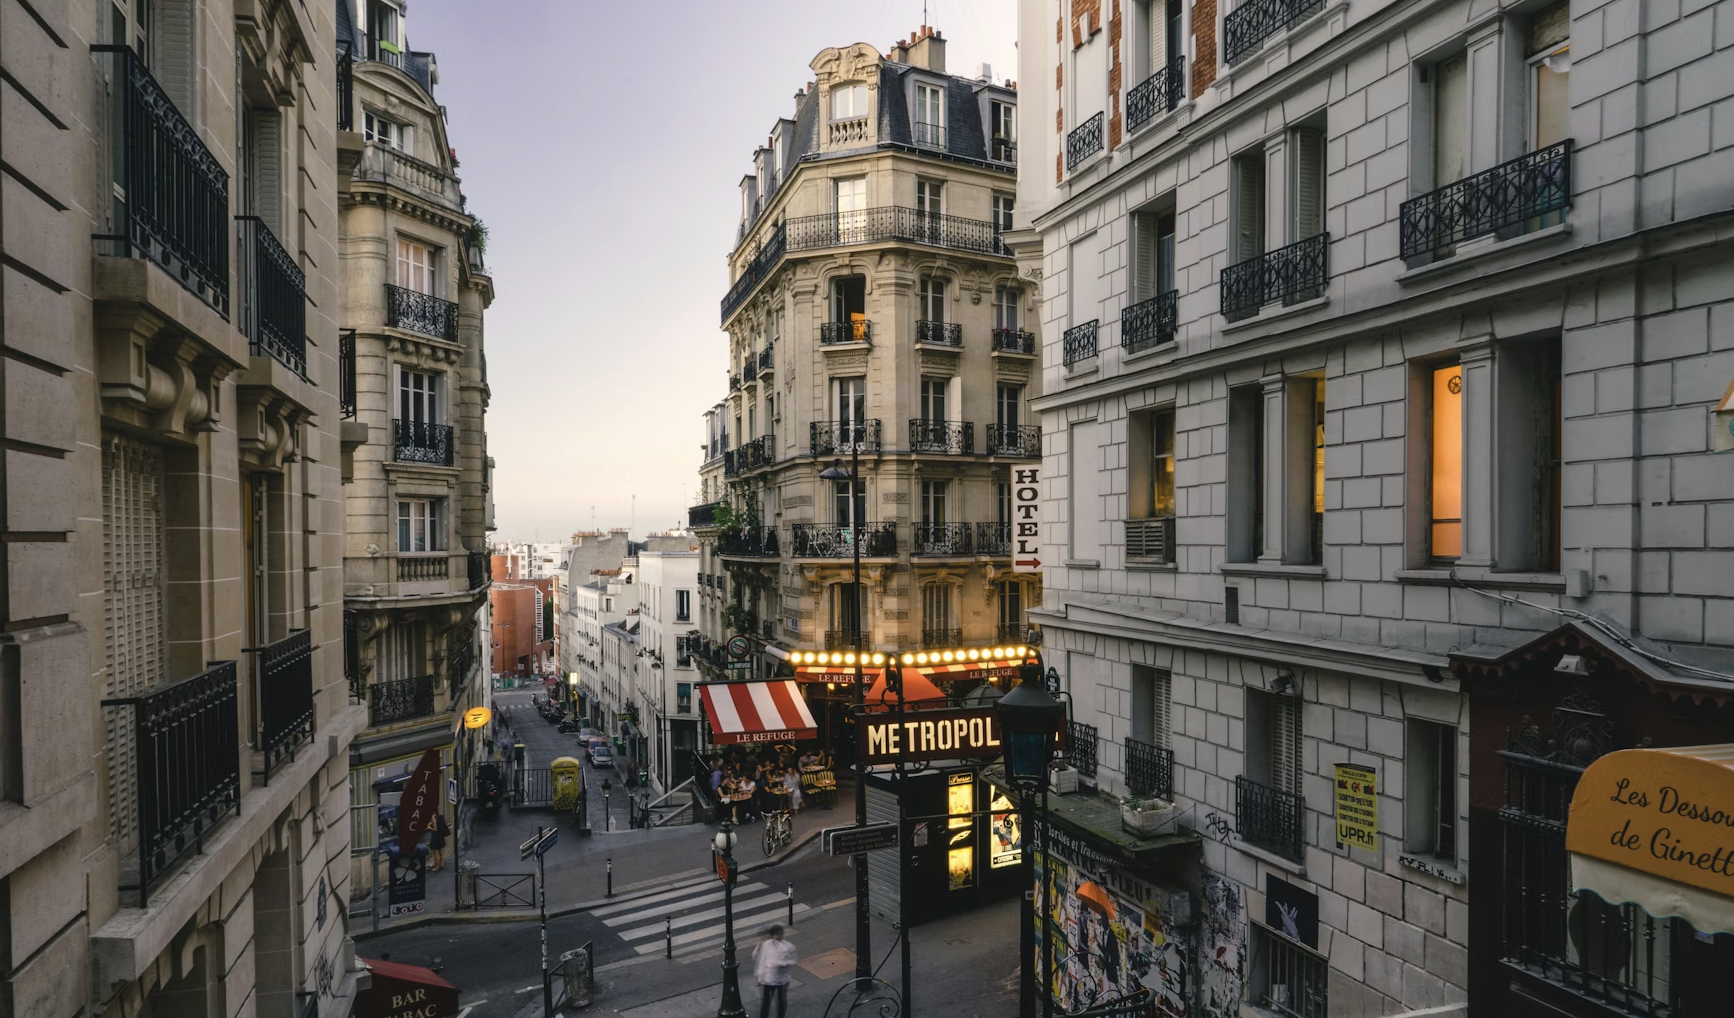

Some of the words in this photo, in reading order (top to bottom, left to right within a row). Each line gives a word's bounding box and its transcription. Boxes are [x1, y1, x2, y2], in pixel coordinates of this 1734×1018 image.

[1015, 469, 1039, 554] HOTEL
[819, 674, 832, 682] LE
[970, 670, 980, 678] LE
[736, 733, 750, 742] LE
[753, 731, 796, 741] REFUGE
[868, 717, 1000, 755] METROPOL
[1610, 778, 1650, 808] Les
[409, 770, 432, 832] TABAC
[1356, 797, 1363, 806] DE
[1354, 816, 1359, 824] DE
[1339, 824, 1374, 846] UPR.fr
[1071, 840, 1078, 851] et
[1610, 819, 1642, 850] de
[1650, 828, 1734, 877] Ginett
[392, 902, 423, 914] LOTO
[391, 988, 427, 1009] BAR
[384, 1004, 437, 1018] BAC
